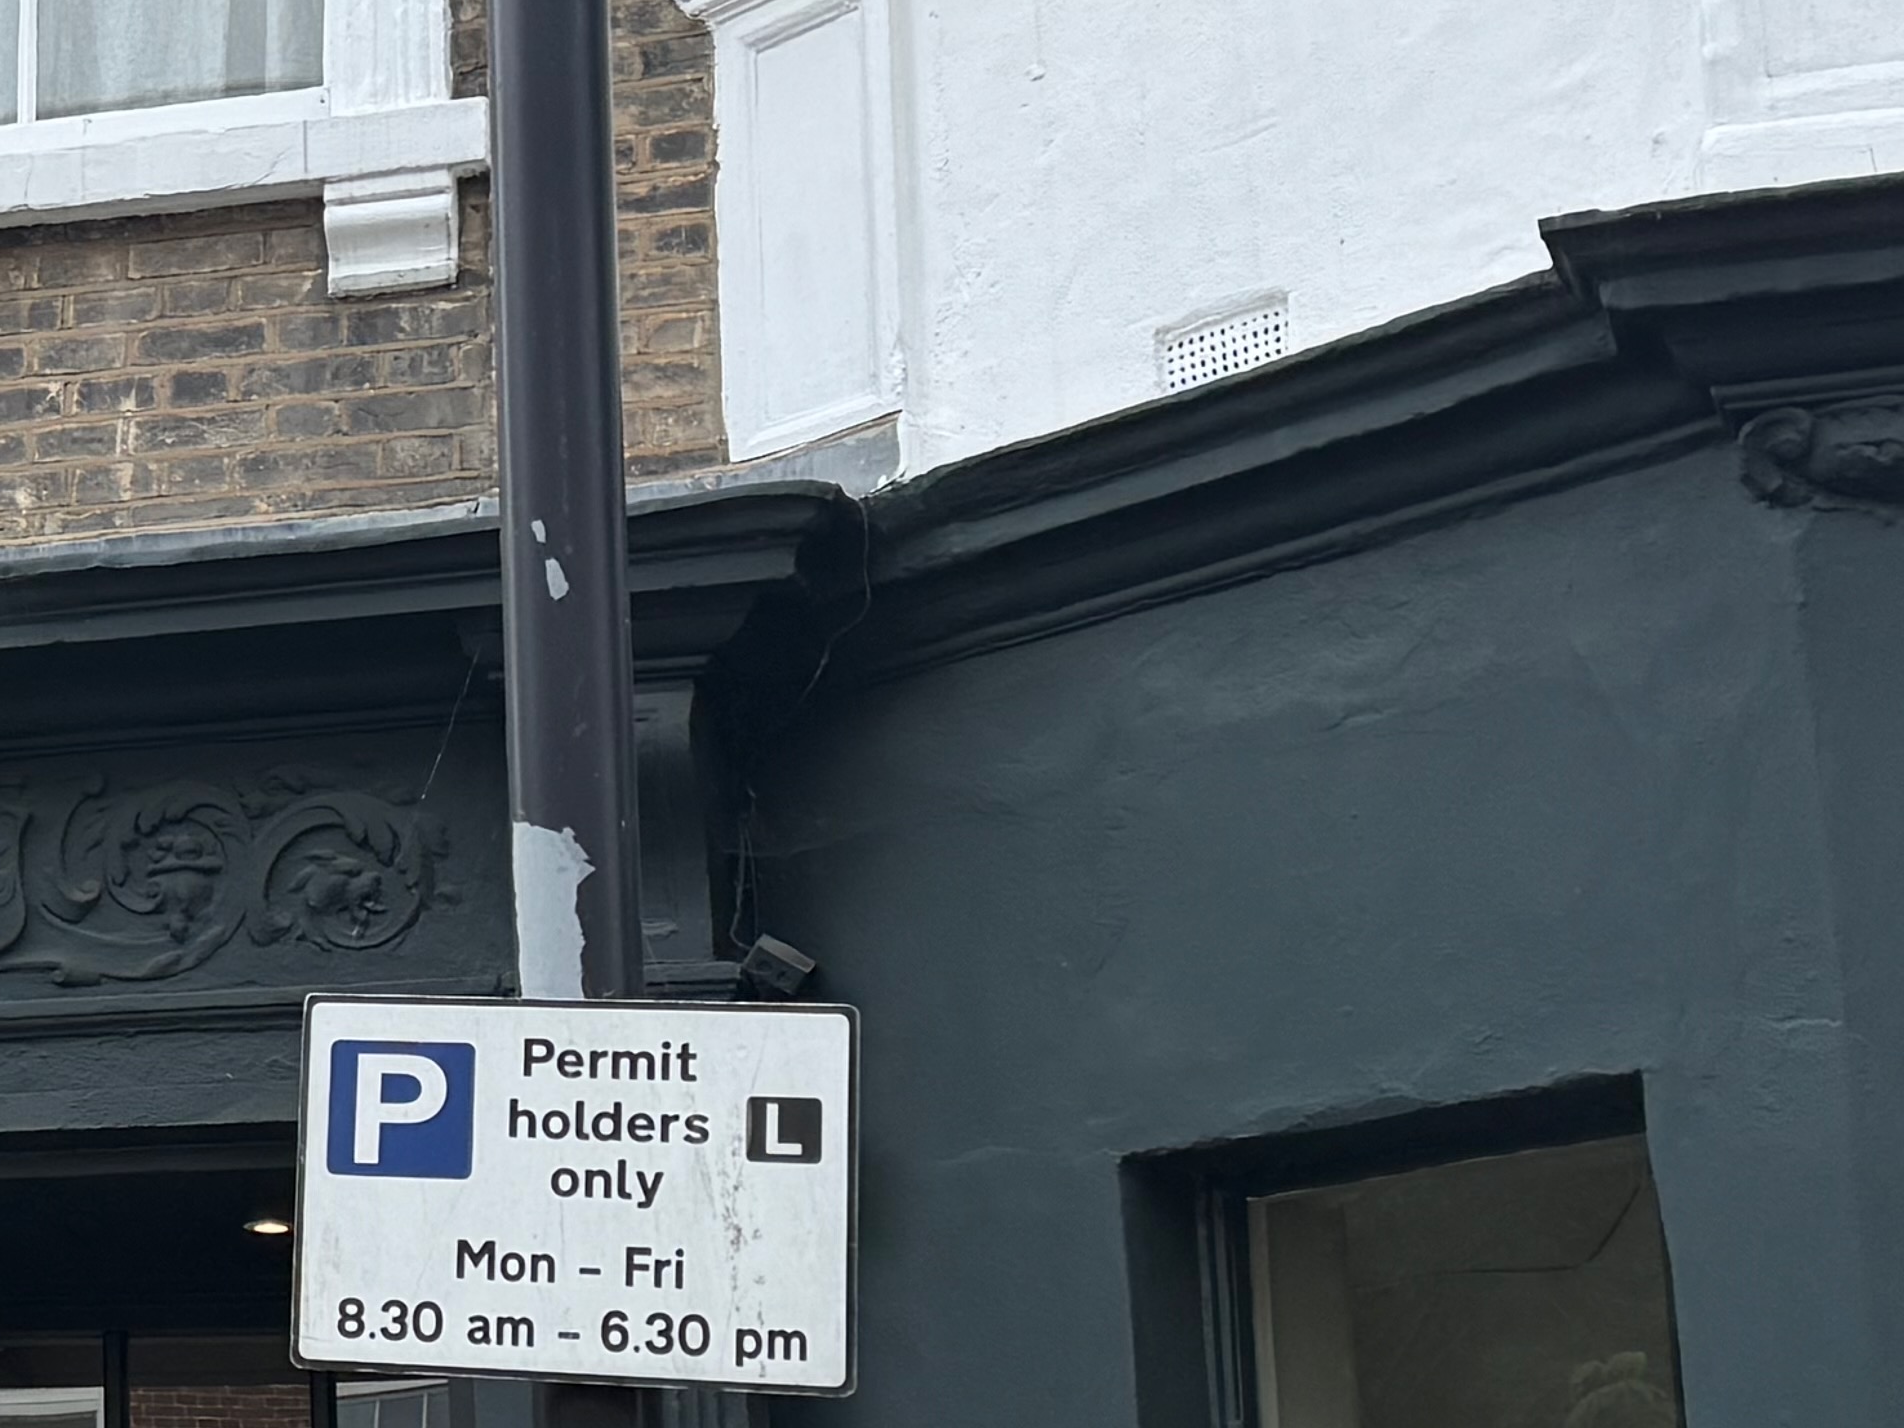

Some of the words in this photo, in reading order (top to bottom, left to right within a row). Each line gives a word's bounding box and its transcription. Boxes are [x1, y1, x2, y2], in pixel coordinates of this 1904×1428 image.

[522, 1037, 698, 1083] Permit
[353, 1052, 449, 1166] P
[508, 1098, 710, 1145] holders
[765, 1102, 804, 1157] L
[550, 1159, 664, 1209] only
[456, 1239, 556, 1285] Mon
[624, 1247, 686, 1290] Fri
[336, 1297, 444, 1343] 8.30
[466, 1313, 536, 1349] am
[600, 1309, 711, 1357] 6.30
[735, 1326, 808, 1367] pm
